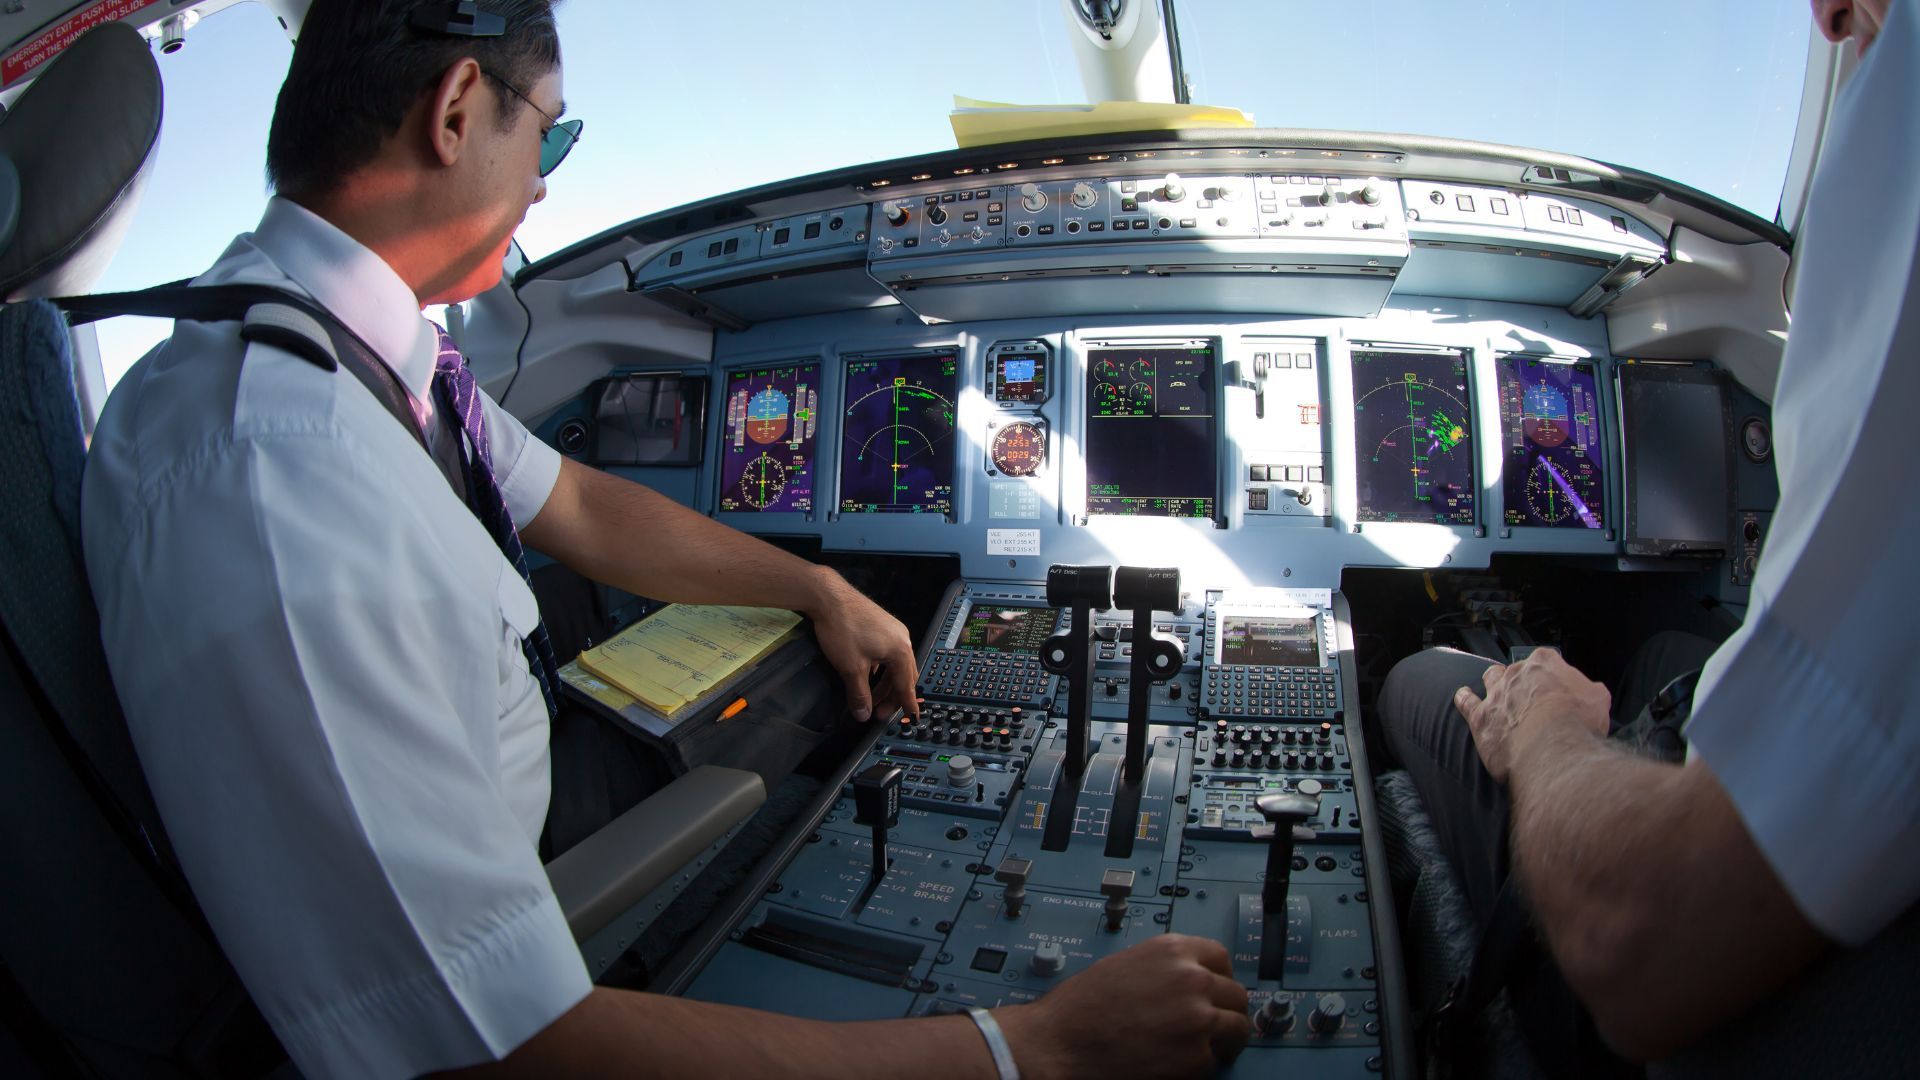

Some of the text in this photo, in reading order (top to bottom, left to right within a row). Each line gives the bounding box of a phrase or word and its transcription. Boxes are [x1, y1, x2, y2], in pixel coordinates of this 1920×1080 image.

[7, 31, 55, 68] EMERGENCY
[55, 22, 73, 38] EXIT
[81, 3, 105, 23] PUSH
[23, 53, 45, 71] TURN
[46, 40, 62, 56] THE
[119, 0, 145, 17] SLIDE
[904, 808, 929, 817] CALLS
[898, 849, 923, 857] ARMED
[917, 881, 955, 894] SPEED
[913, 890, 953, 903] BRAKE
[1042, 896, 1102, 909] ENG MASTER
[877, 907, 894, 915] FULL
[1247, 934, 1253, 942] 3
[1319, 929, 1358, 938] FLAPS
[1028, 932, 1084, 945] ENG START
[1296, 935, 1302, 943] 3
[1291, 955, 1309, 963] FULL
